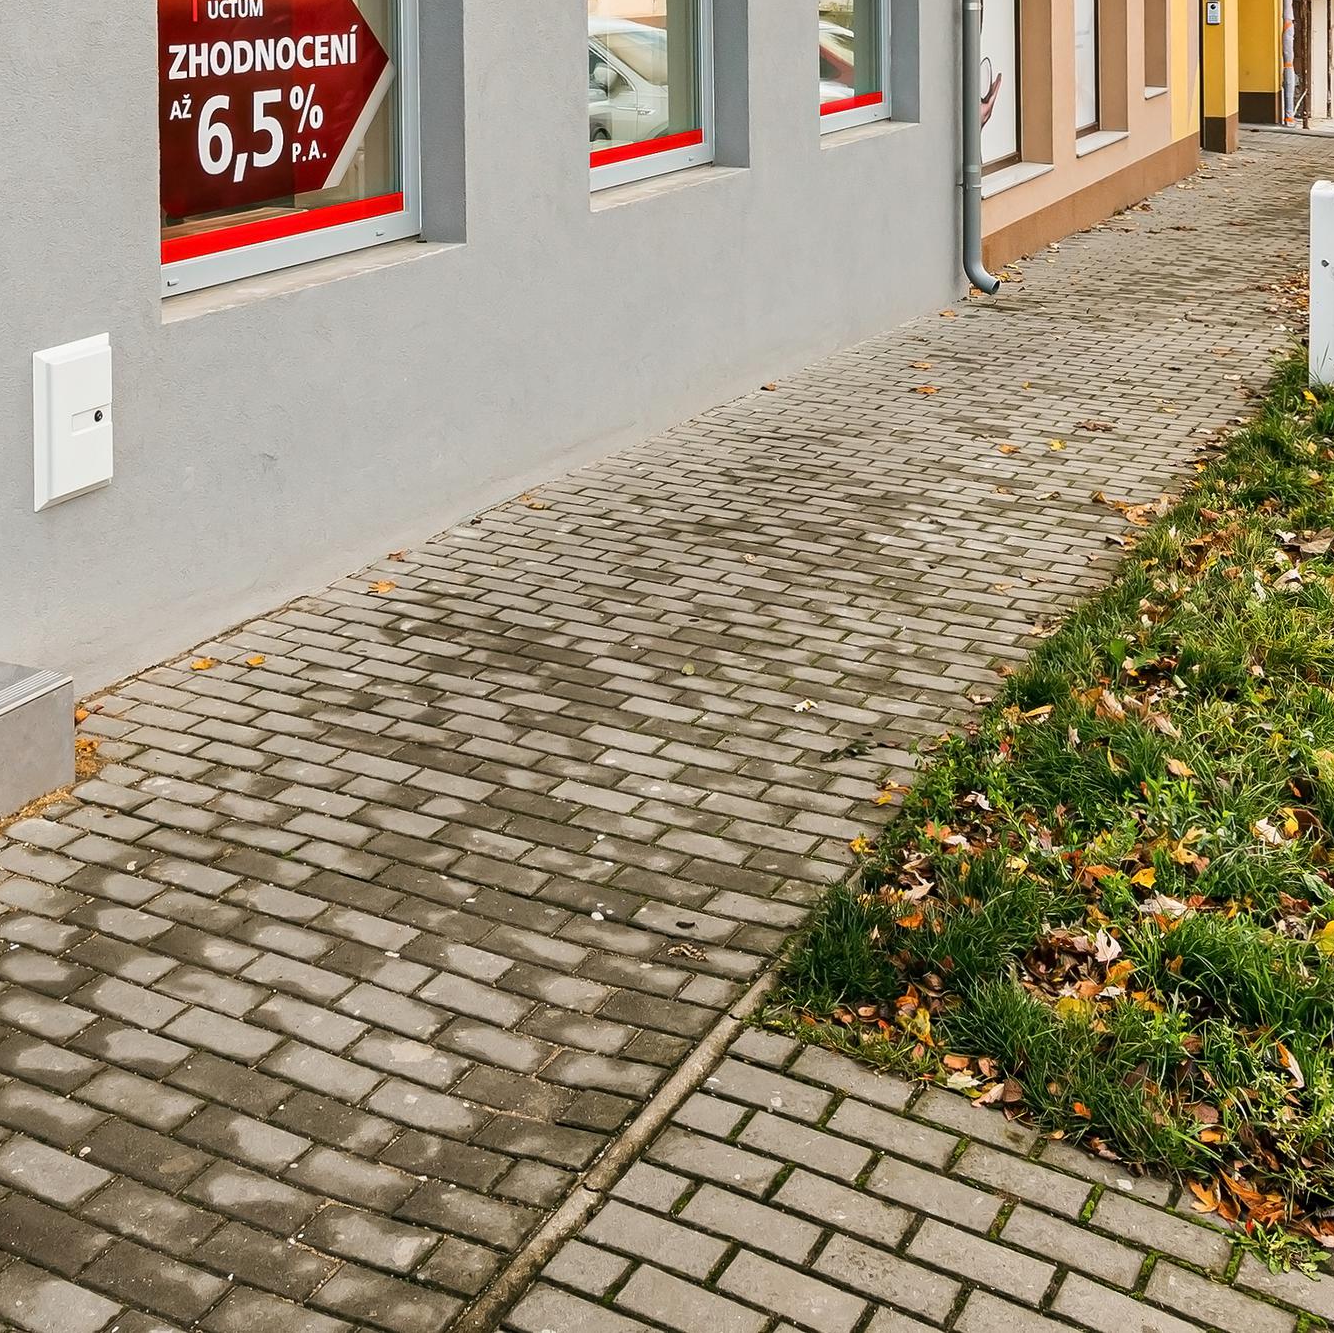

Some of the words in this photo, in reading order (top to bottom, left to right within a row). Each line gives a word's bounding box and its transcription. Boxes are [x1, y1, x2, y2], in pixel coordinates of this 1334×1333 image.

[167, 25, 358, 81] ZHODNOCENÍ
[169, 94, 192, 121] AŽ
[291, 139, 328, 164] P.A.
